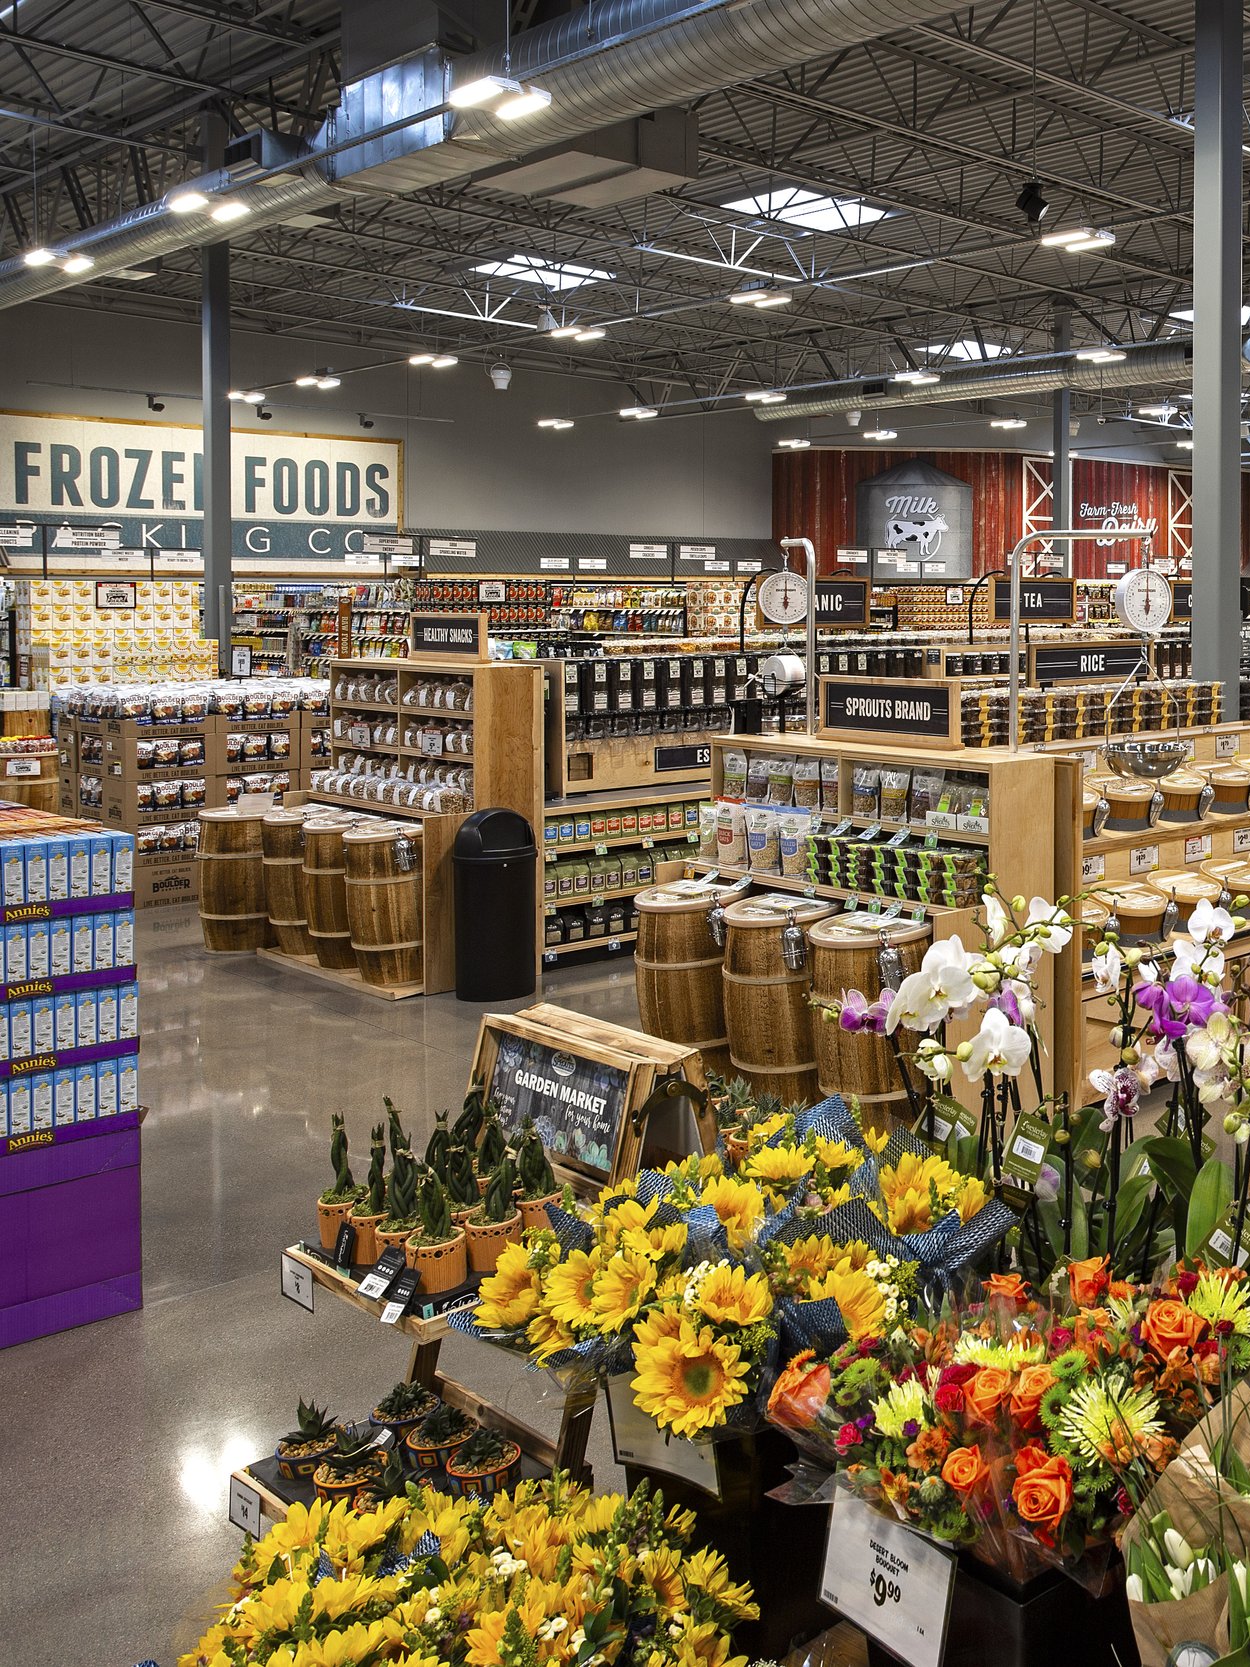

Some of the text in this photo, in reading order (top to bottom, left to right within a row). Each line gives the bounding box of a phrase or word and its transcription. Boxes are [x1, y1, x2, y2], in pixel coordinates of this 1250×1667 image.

[14, 441, 389, 518] FROZE FOODS
[885, 494, 939, 515] Milk
[1080, 502, 1138, 517] Farm-Fresh
[1097, 514, 1159, 547] Dairy
[1023, 592, 1043, 608] TEA
[424, 628, 473, 643] HEALTHY SNACKS
[1080, 654, 1105, 672] RICE
[304, 692, 330, 700] BOULDE
[846, 697, 931, 721] SPROUTS BRAND
[155, 743, 178, 751] BOULDE
[184, 781, 205, 790] BOULD
[181, 851, 195, 860] BOULD
[152, 878, 191, 893] BOULDER
[5, 904, 51, 922] Annie's
[7, 981, 53, 999] Annie's
[11, 1055, 57, 1075] Annie's
[515, 1069, 606, 1116] GARDEN MARKET
[564, 1104, 611, 1134] for your home
[9, 1131, 54, 1150] Annie's
[869, 1538, 909, 1574] DESERT BLOOM
[876, 1554, 900, 1577] BOUQUET
